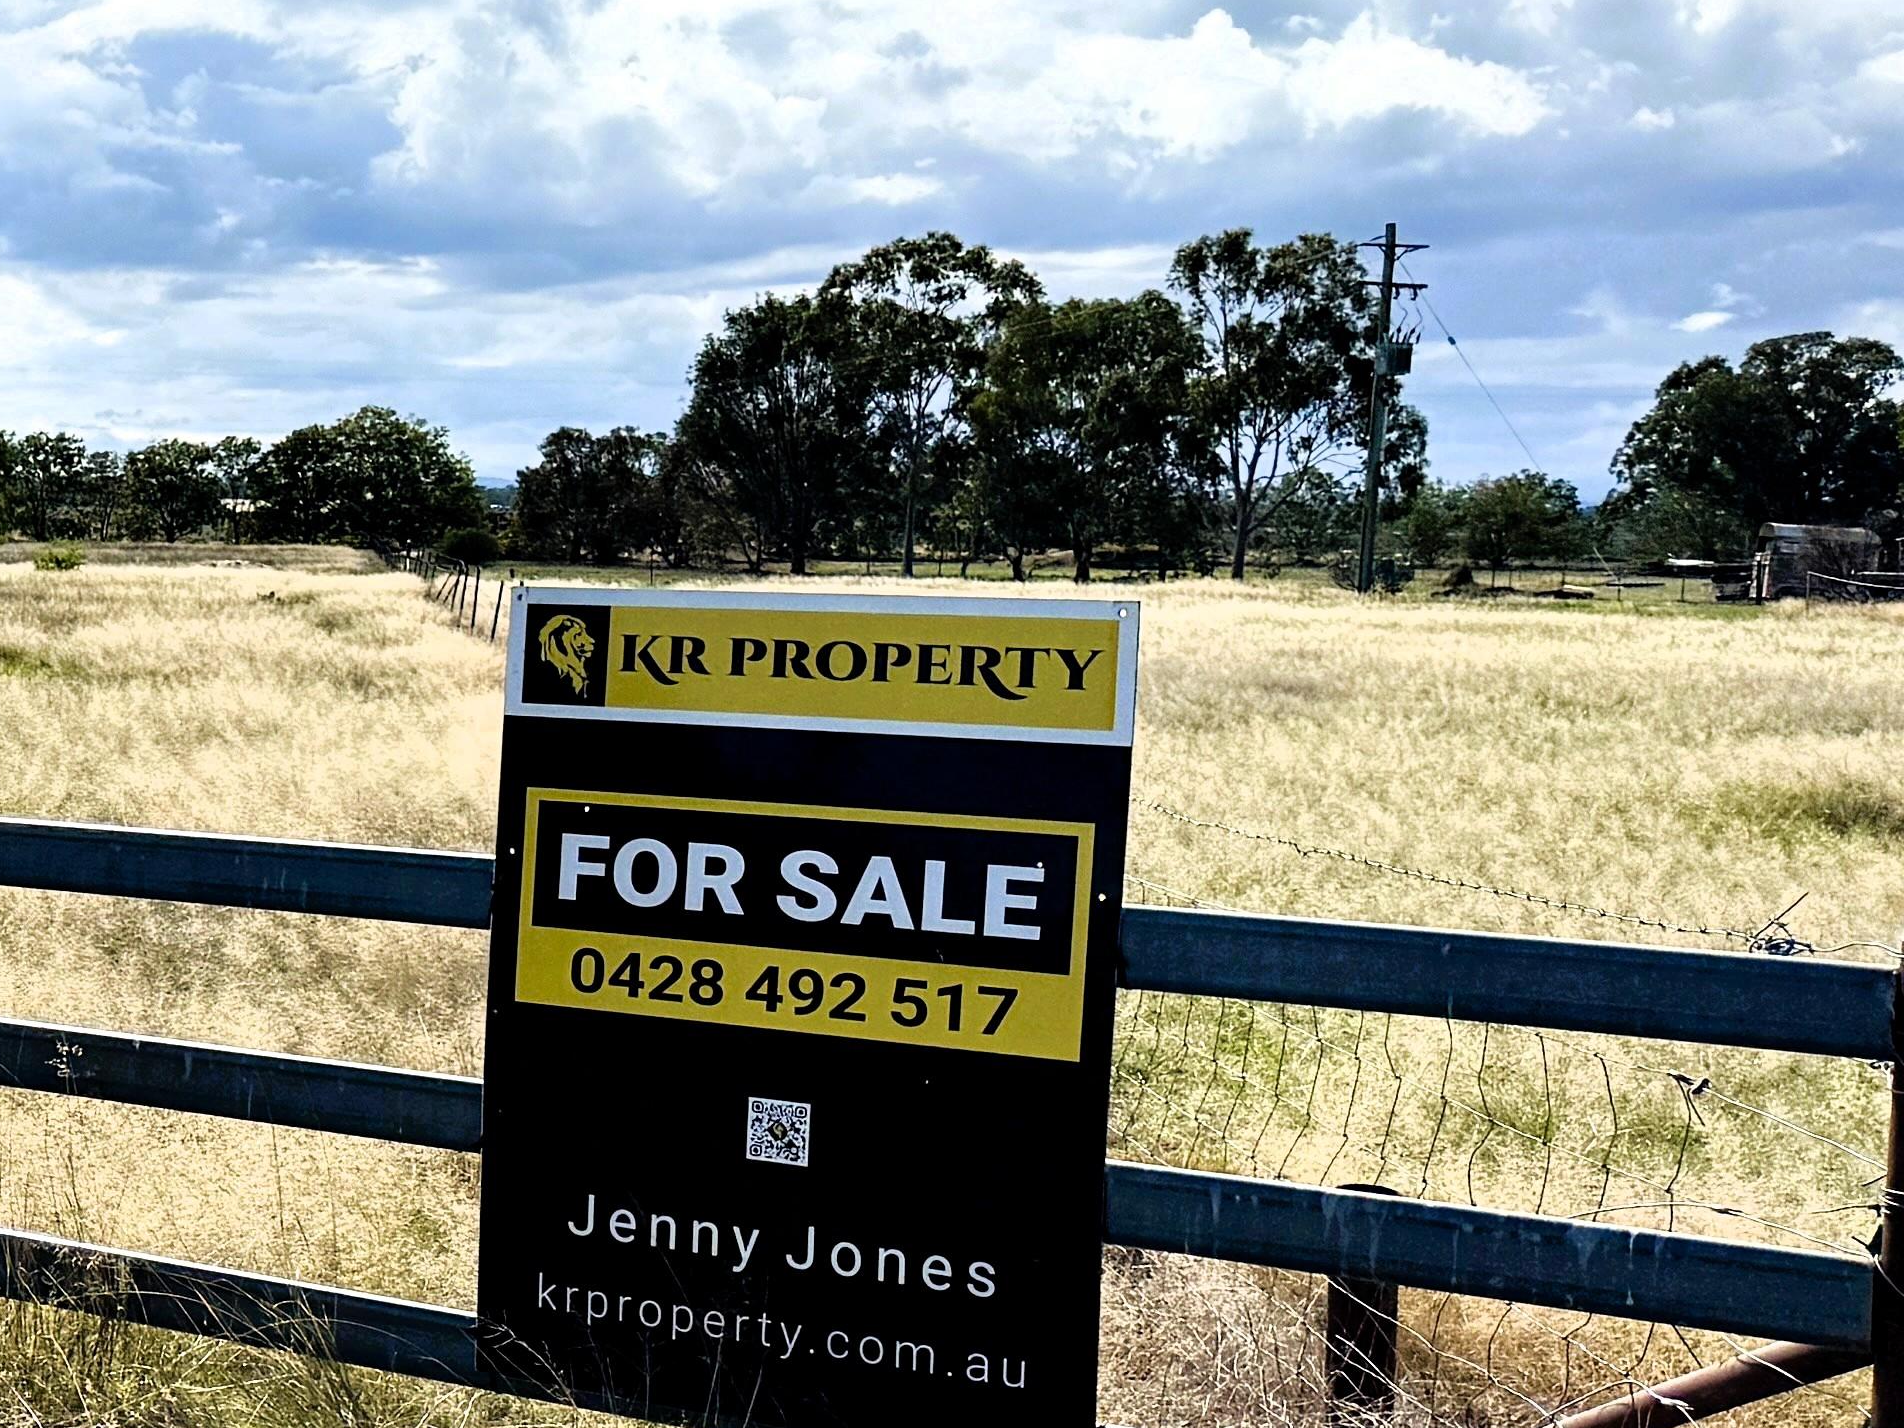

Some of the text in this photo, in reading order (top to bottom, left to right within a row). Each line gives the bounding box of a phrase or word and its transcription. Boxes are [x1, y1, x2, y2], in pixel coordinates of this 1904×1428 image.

[620, 633, 1106, 701] KR PROPERTY
[557, 832, 1045, 941] FOR SALE
[569, 947, 1019, 1036] 0428 492 517
[568, 1194, 997, 1298] Jenny Jones
[537, 1272, 1027, 1389] krproperty.com.au
